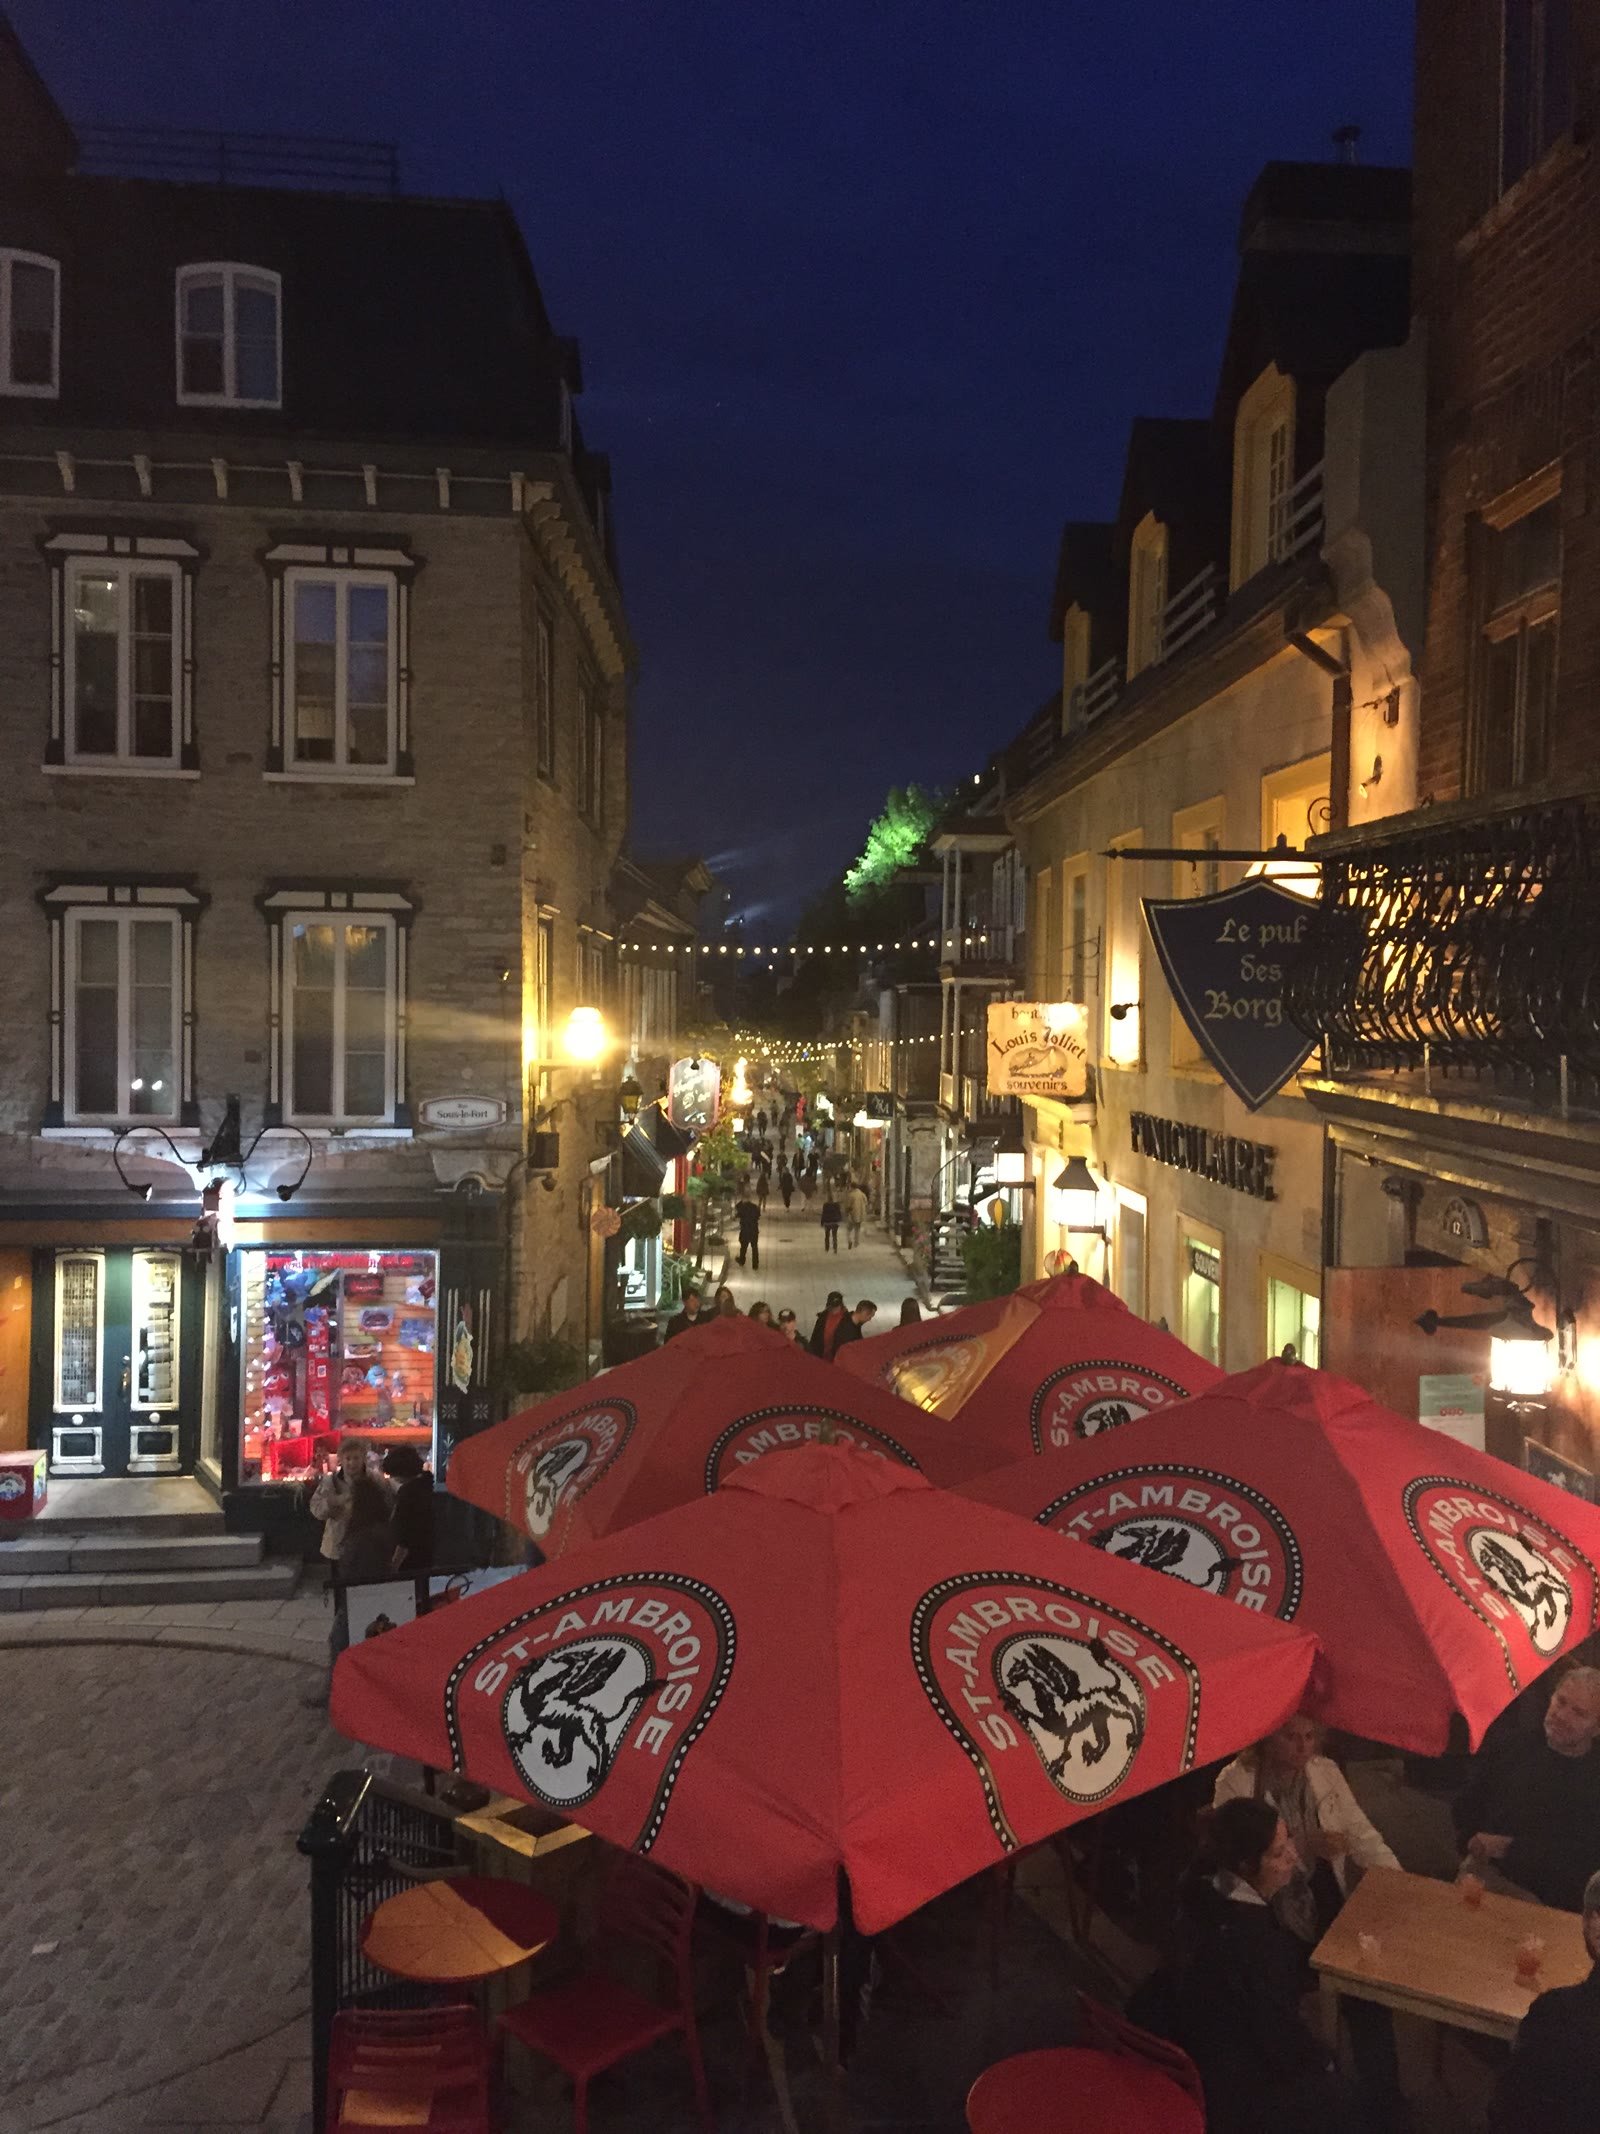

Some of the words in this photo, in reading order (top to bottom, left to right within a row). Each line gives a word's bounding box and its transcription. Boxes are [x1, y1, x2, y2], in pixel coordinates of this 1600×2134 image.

[1215, 918, 1251, 943] Le
[1240, 954, 1283, 982] des
[1204, 989, 1284, 1028] Borg
[991, 1030, 1038, 1058] Louis
[1039, 1026, 1087, 1060] Jolliet
[1006, 1079, 1068, 1090] souvenirs
[1453, 1221, 1461, 1235] 12
[1050, 1375, 1176, 1447] ST-AMBRO
[1428, 1496, 1578, 1621] ST-AMBROISE
[474, 1598, 701, 1755] ST-AMBROISE
[945, 1597, 1177, 1752] ST-AMBROISE
